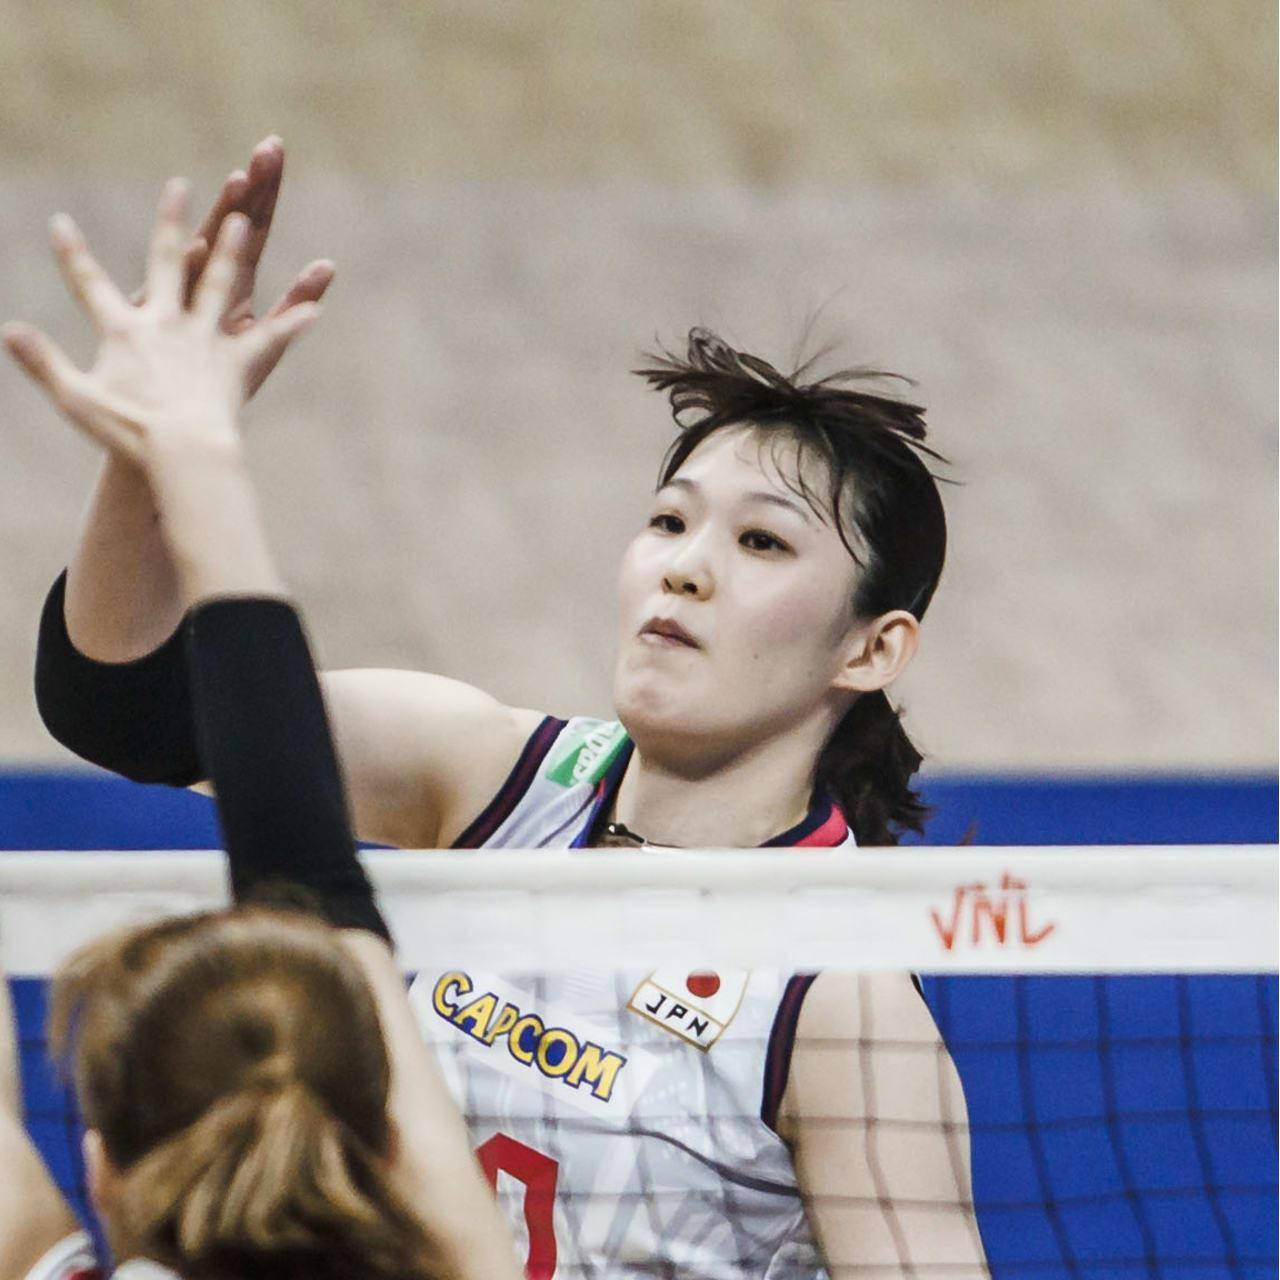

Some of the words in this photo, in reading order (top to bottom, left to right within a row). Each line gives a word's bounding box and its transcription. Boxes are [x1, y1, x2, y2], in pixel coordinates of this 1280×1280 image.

[929, 870, 1057, 950] VNL
[432, 970, 628, 1103] CAPCOM
[645, 993, 710, 1038] JPN
